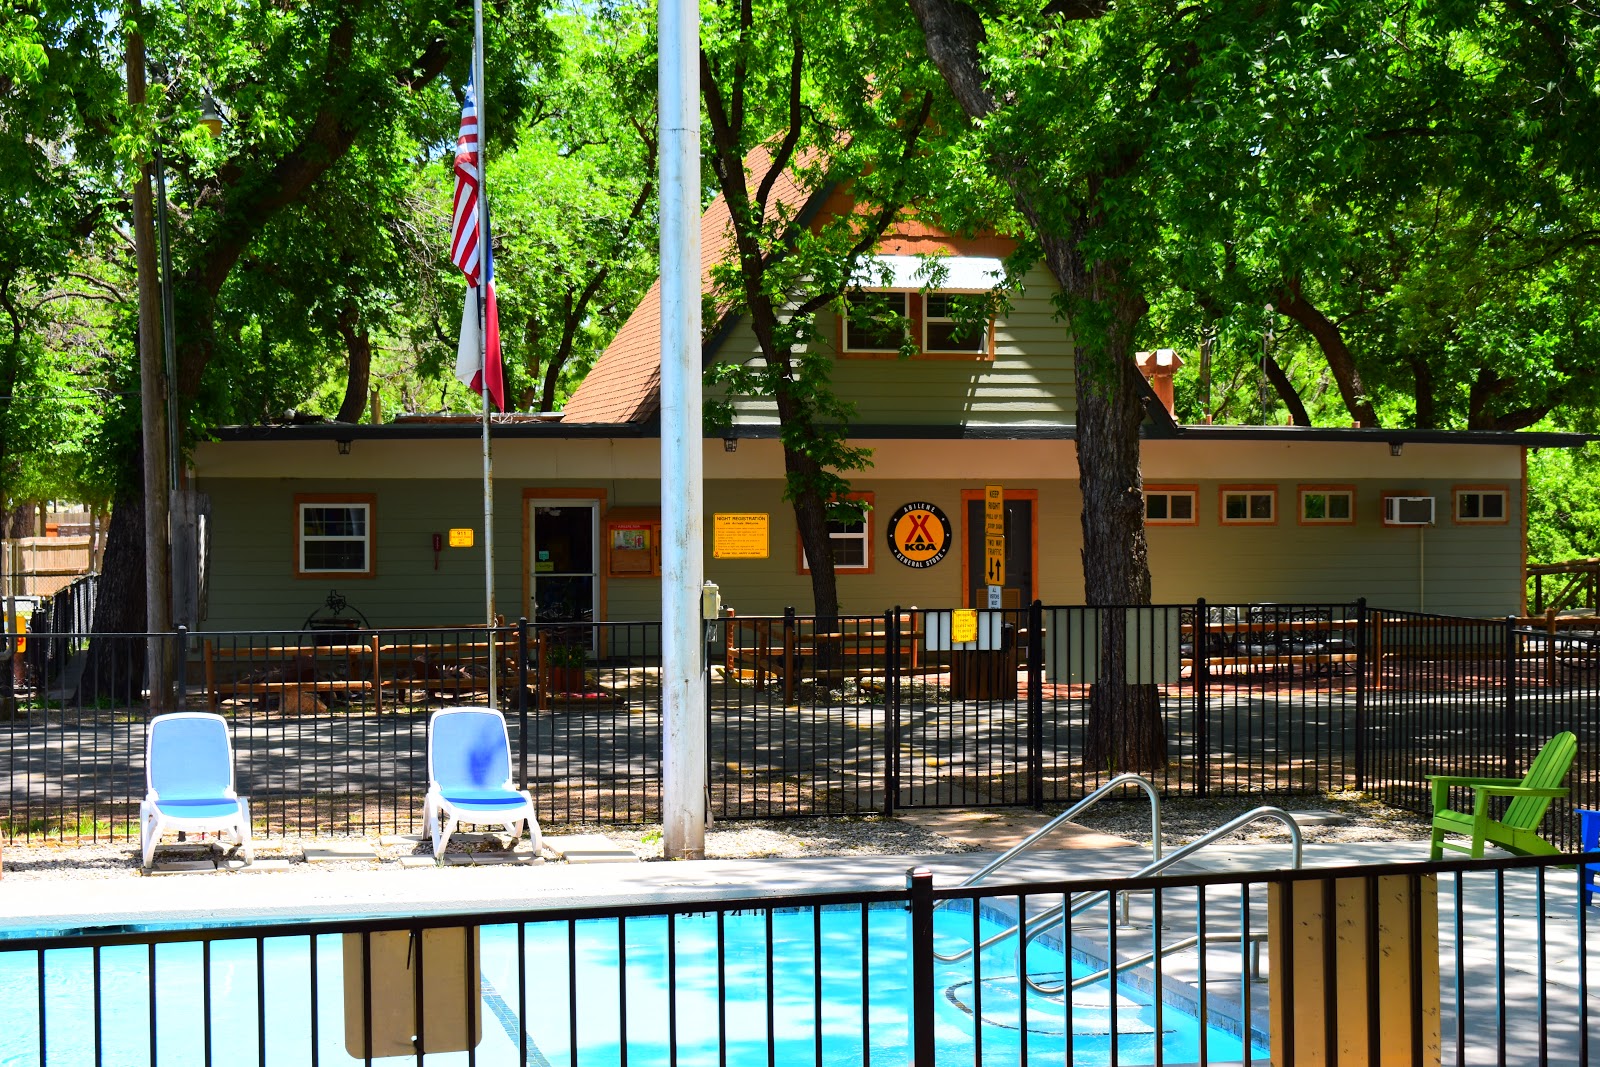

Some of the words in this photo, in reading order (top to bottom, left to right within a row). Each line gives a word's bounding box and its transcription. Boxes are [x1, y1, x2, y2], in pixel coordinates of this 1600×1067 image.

[990, 490, 999, 498] KEEP
[903, 503, 936, 513] ABILENE
[988, 502, 1000, 510] RIGHT
[905, 543, 937, 551] KOA
[988, 548, 1002, 556] TRAFFIC
[896, 553, 924, 568] GENERAL
[925, 552, 944, 567] STORE
